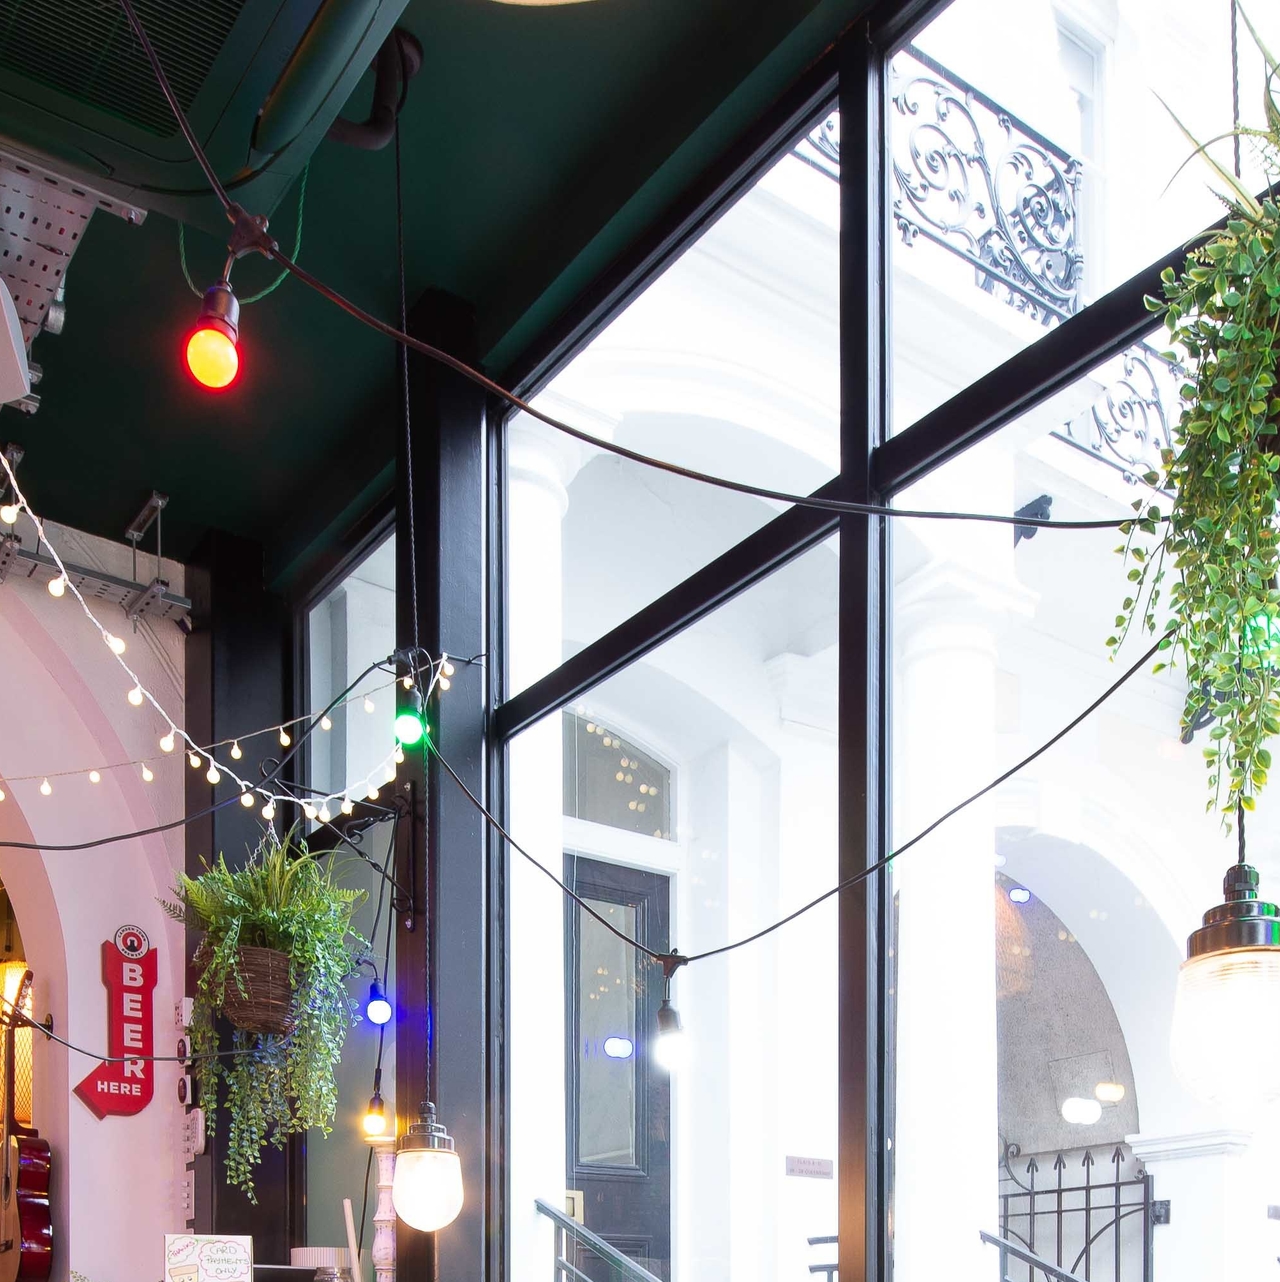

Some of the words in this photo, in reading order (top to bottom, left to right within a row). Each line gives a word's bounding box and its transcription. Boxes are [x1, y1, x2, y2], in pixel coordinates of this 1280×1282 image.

[122, 962, 146, 1079] BEER
[97, 1080, 142, 1096] HERE
[210, 1245, 237, 1255] CARD
[204, 1255, 249, 1265] PAYMENTS
[215, 1267, 237, 1275] ONLY
